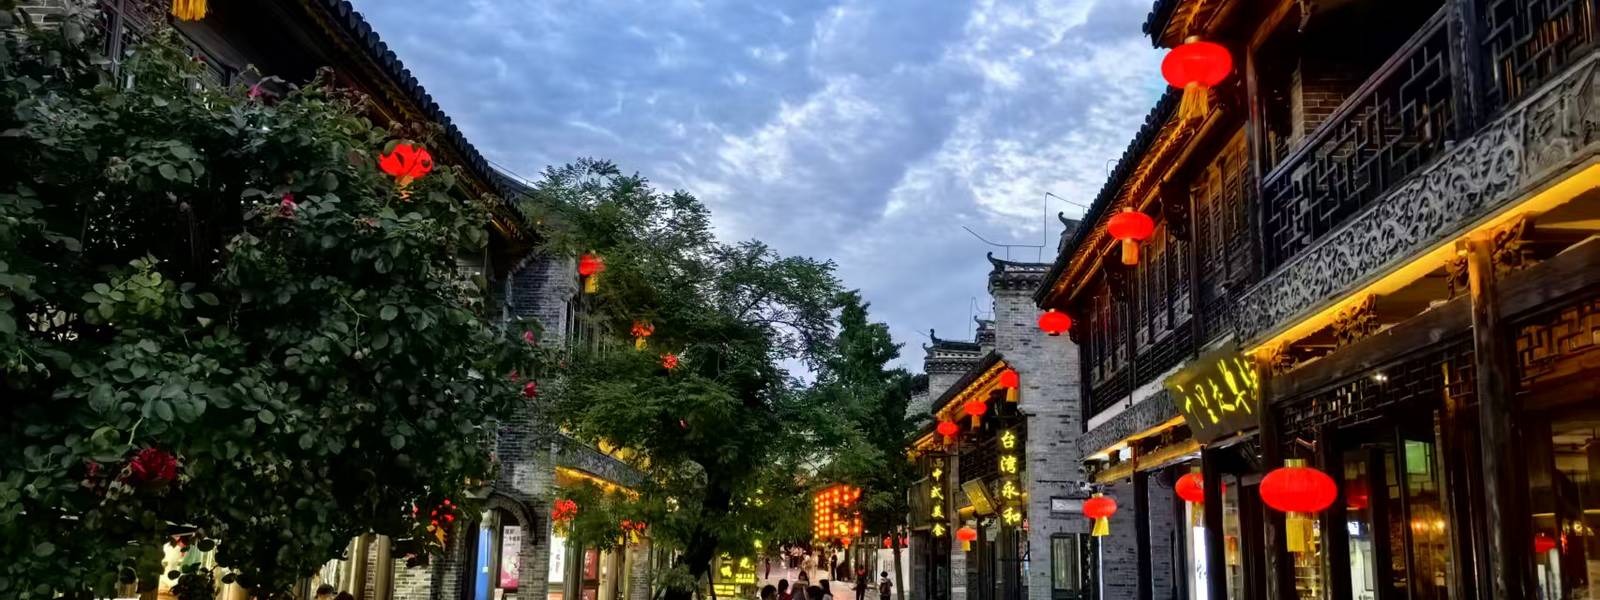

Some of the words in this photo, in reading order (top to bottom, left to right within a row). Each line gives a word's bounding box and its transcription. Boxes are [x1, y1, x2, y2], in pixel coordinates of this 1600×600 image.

[930, 467, 946, 537] 中式美食
[1000, 430, 1022, 526] 台湾永和
